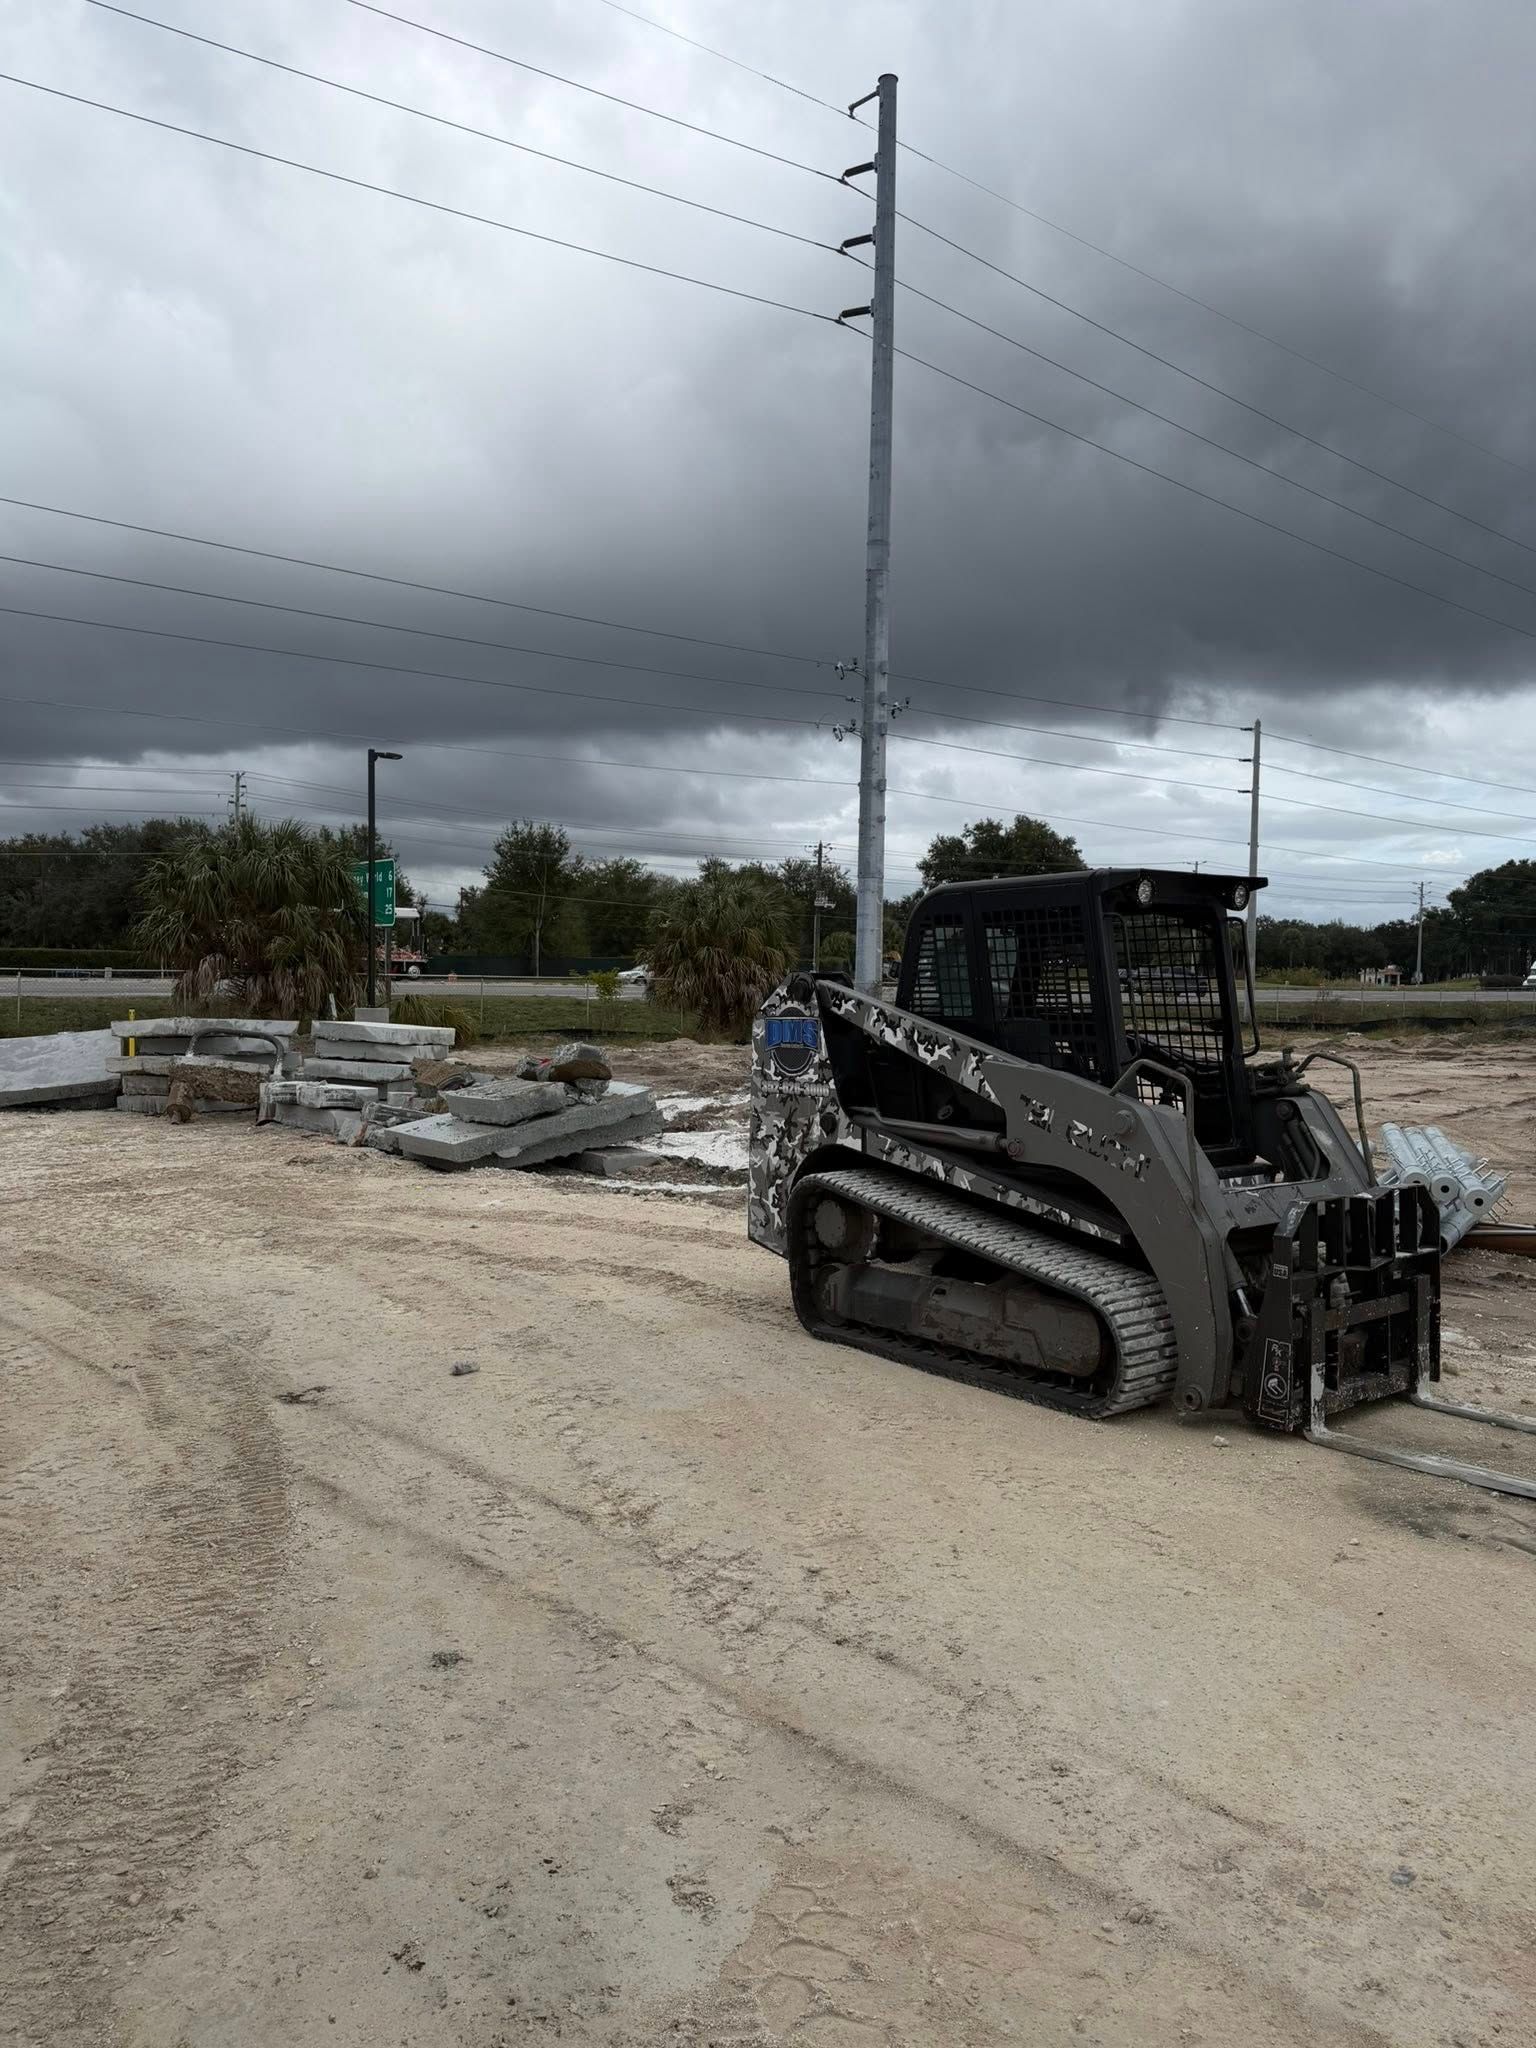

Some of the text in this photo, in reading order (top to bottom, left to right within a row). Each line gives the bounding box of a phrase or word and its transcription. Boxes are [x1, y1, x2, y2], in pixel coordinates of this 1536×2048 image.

[388, 870, 393, 882] 6
[386, 887, 393, 898] 17
[384, 904, 393, 915] 25
[767, 1019, 818, 1048] DMS
